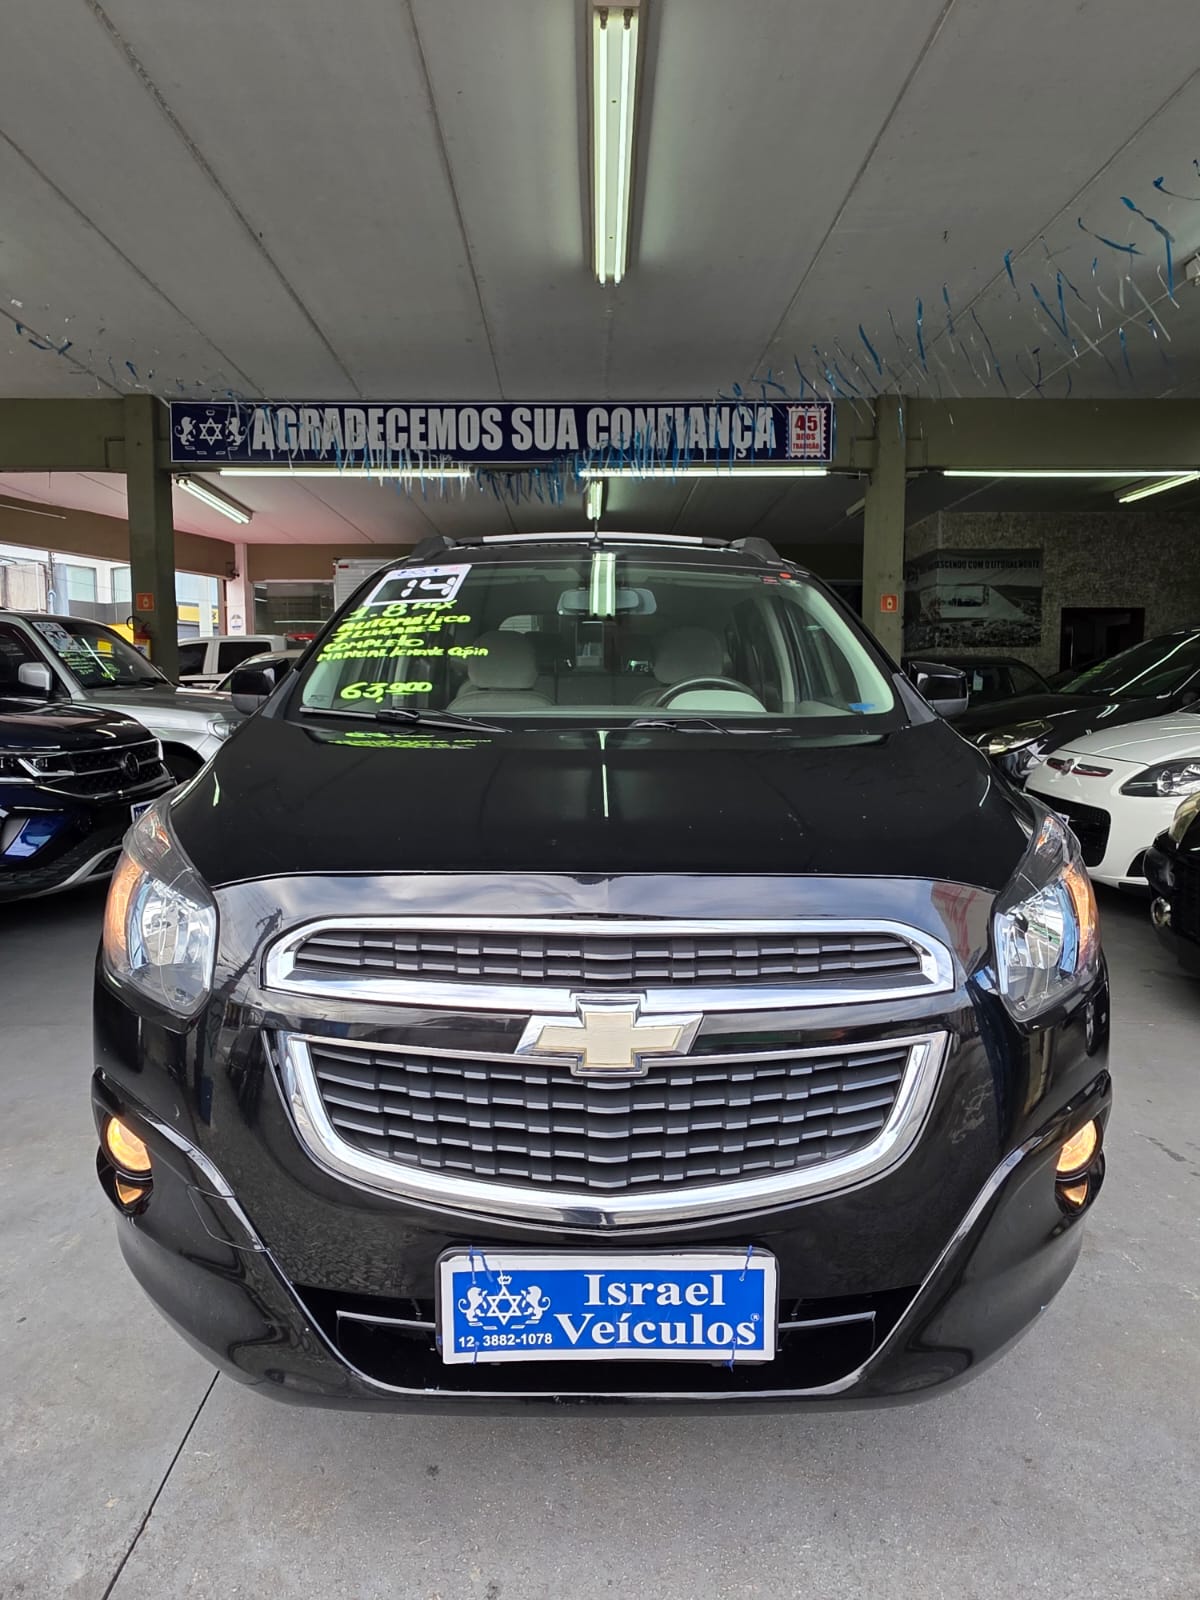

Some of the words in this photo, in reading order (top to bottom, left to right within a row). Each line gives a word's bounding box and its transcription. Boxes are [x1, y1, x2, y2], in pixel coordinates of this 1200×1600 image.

[252, 407, 503, 451] AGRADECEMOS
[511, 407, 580, 451] SUA
[586, 406, 777, 458] CONFIANÇA
[795, 414, 817, 431] 45
[351, 624, 442, 639] LUGARES
[583, 1273, 726, 1306] Israel
[458, 1335, 475, 1348] 12
[482, 1332, 553, 1347] 3882-1078
[553, 1312, 757, 1346] Veículos
